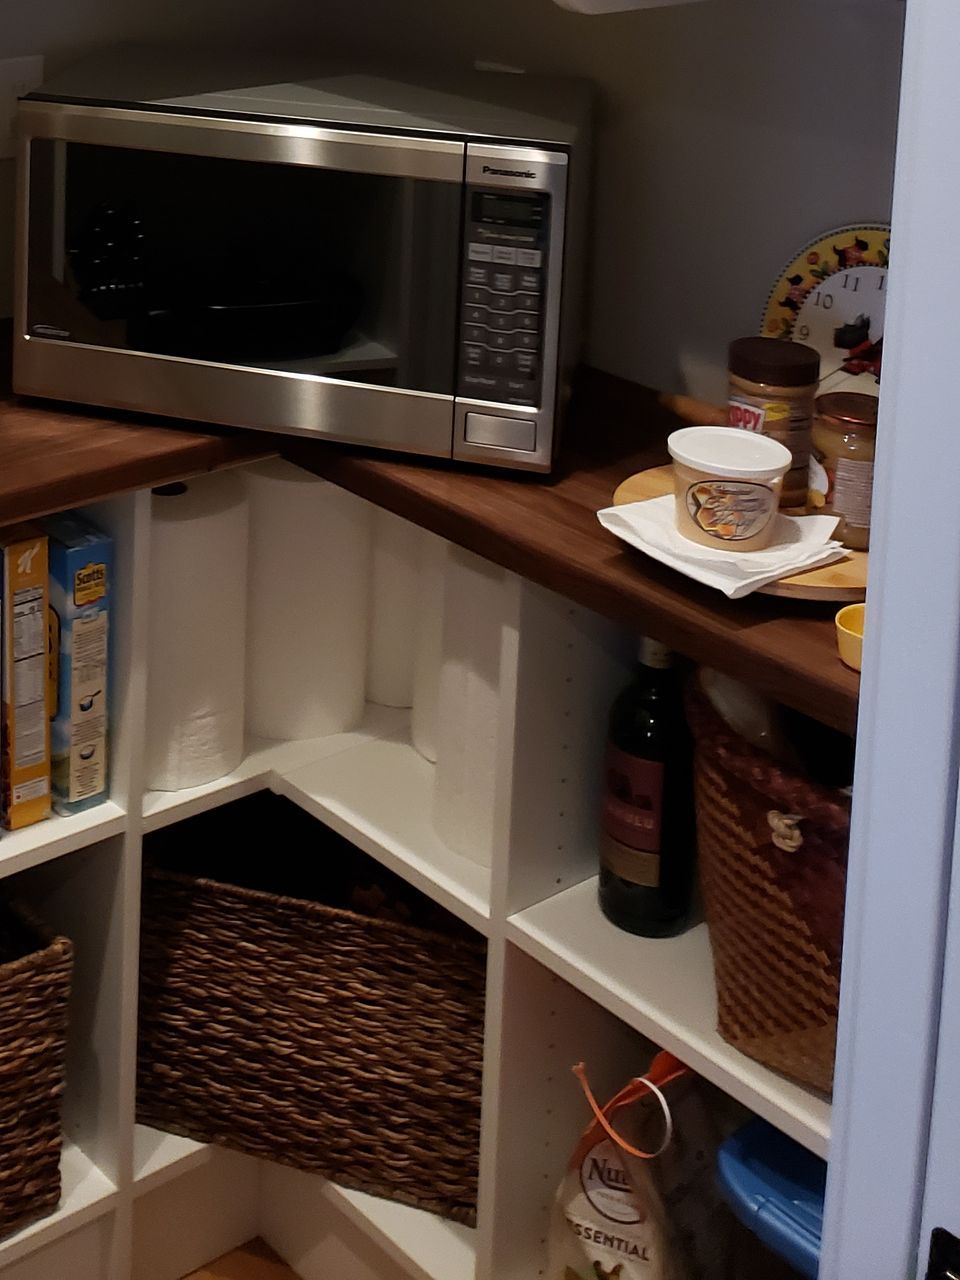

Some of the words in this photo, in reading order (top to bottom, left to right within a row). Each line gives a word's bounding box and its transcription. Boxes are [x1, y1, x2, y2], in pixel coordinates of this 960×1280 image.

[482, 166, 537, 179] Panasonic
[842, 274, 860, 292] 11
[814, 292, 834, 310] 10
[799, 325, 810, 340] 9
